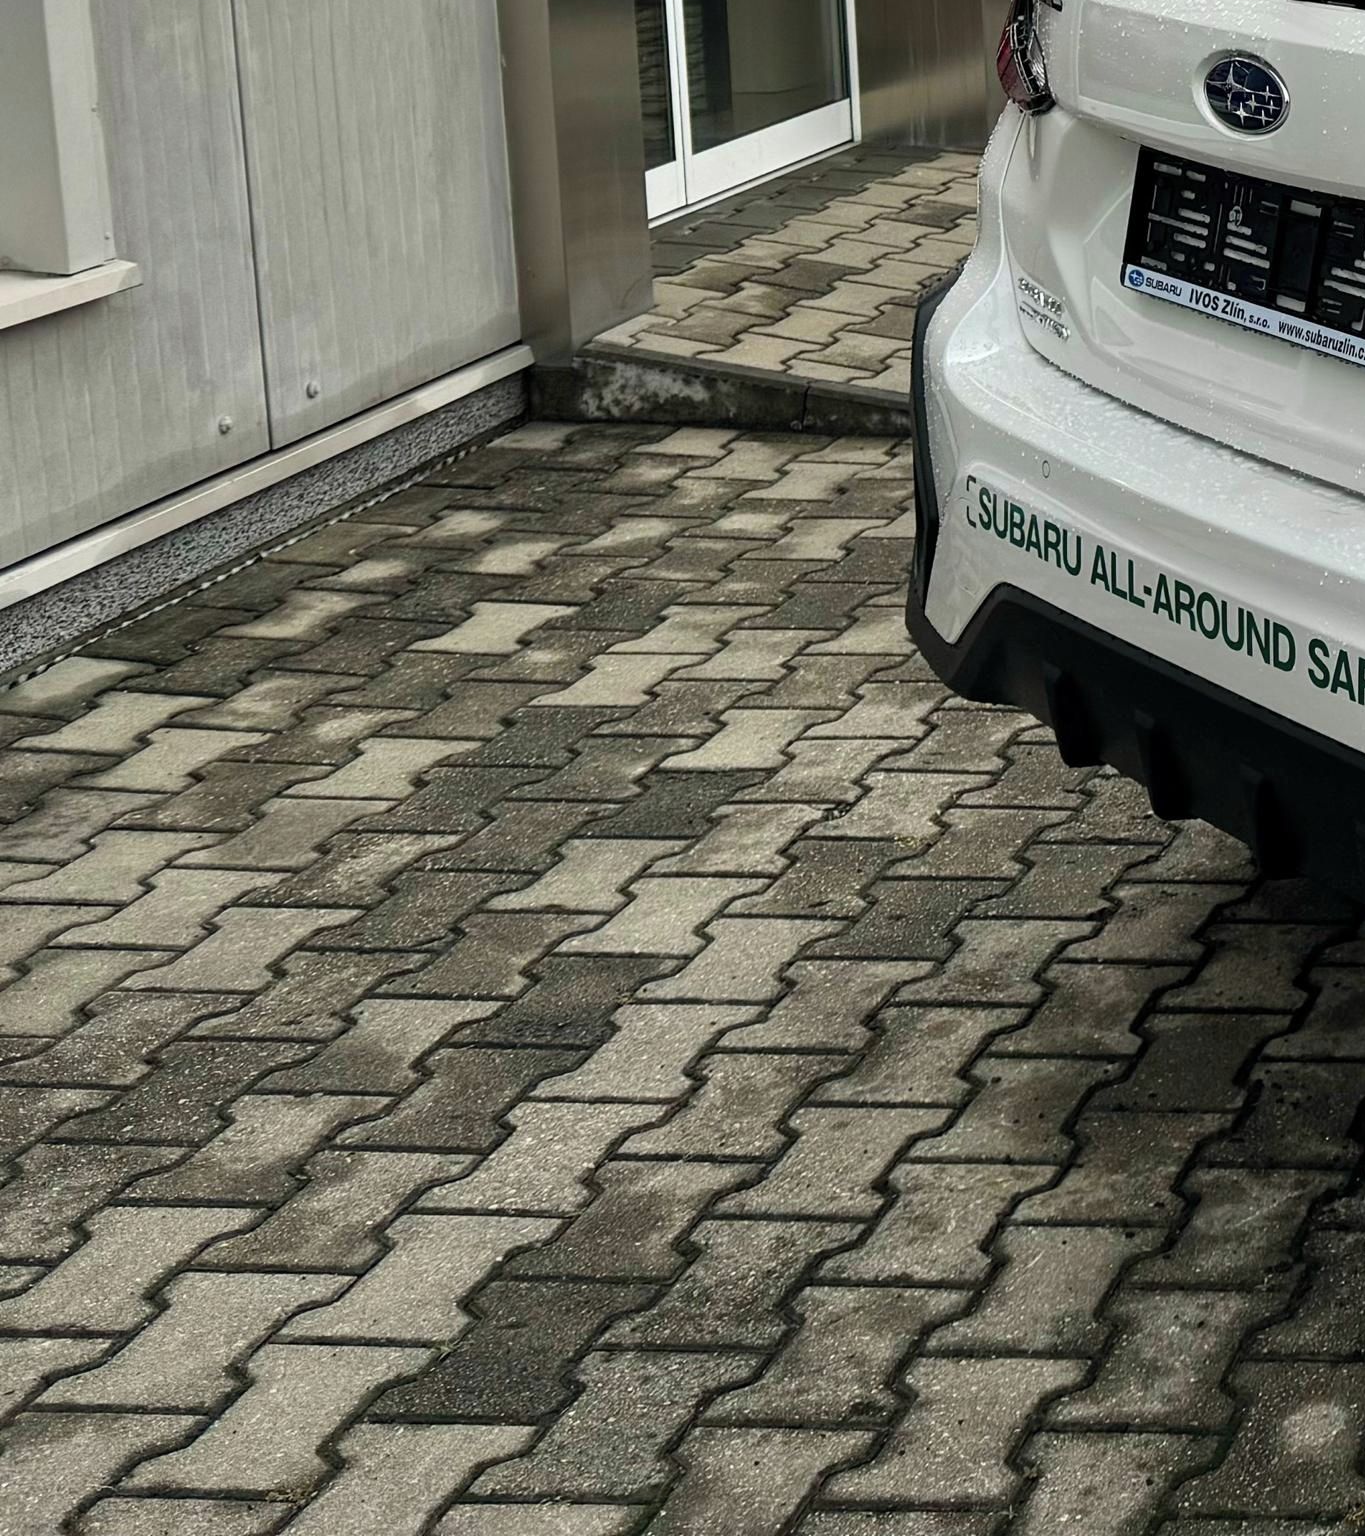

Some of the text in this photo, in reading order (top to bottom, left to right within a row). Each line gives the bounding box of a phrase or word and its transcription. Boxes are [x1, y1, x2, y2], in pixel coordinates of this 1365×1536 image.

[1145, 276, 1183, 297] SUBARU
[1188, 287, 1220, 312] IVOS
[1221, 295, 1247, 323] Zlín,
[1248, 314, 1271, 329] s.r.o.
[978, 486, 1082, 577] SUBARU
[1090, 544, 1296, 672] ALL-AROUND
